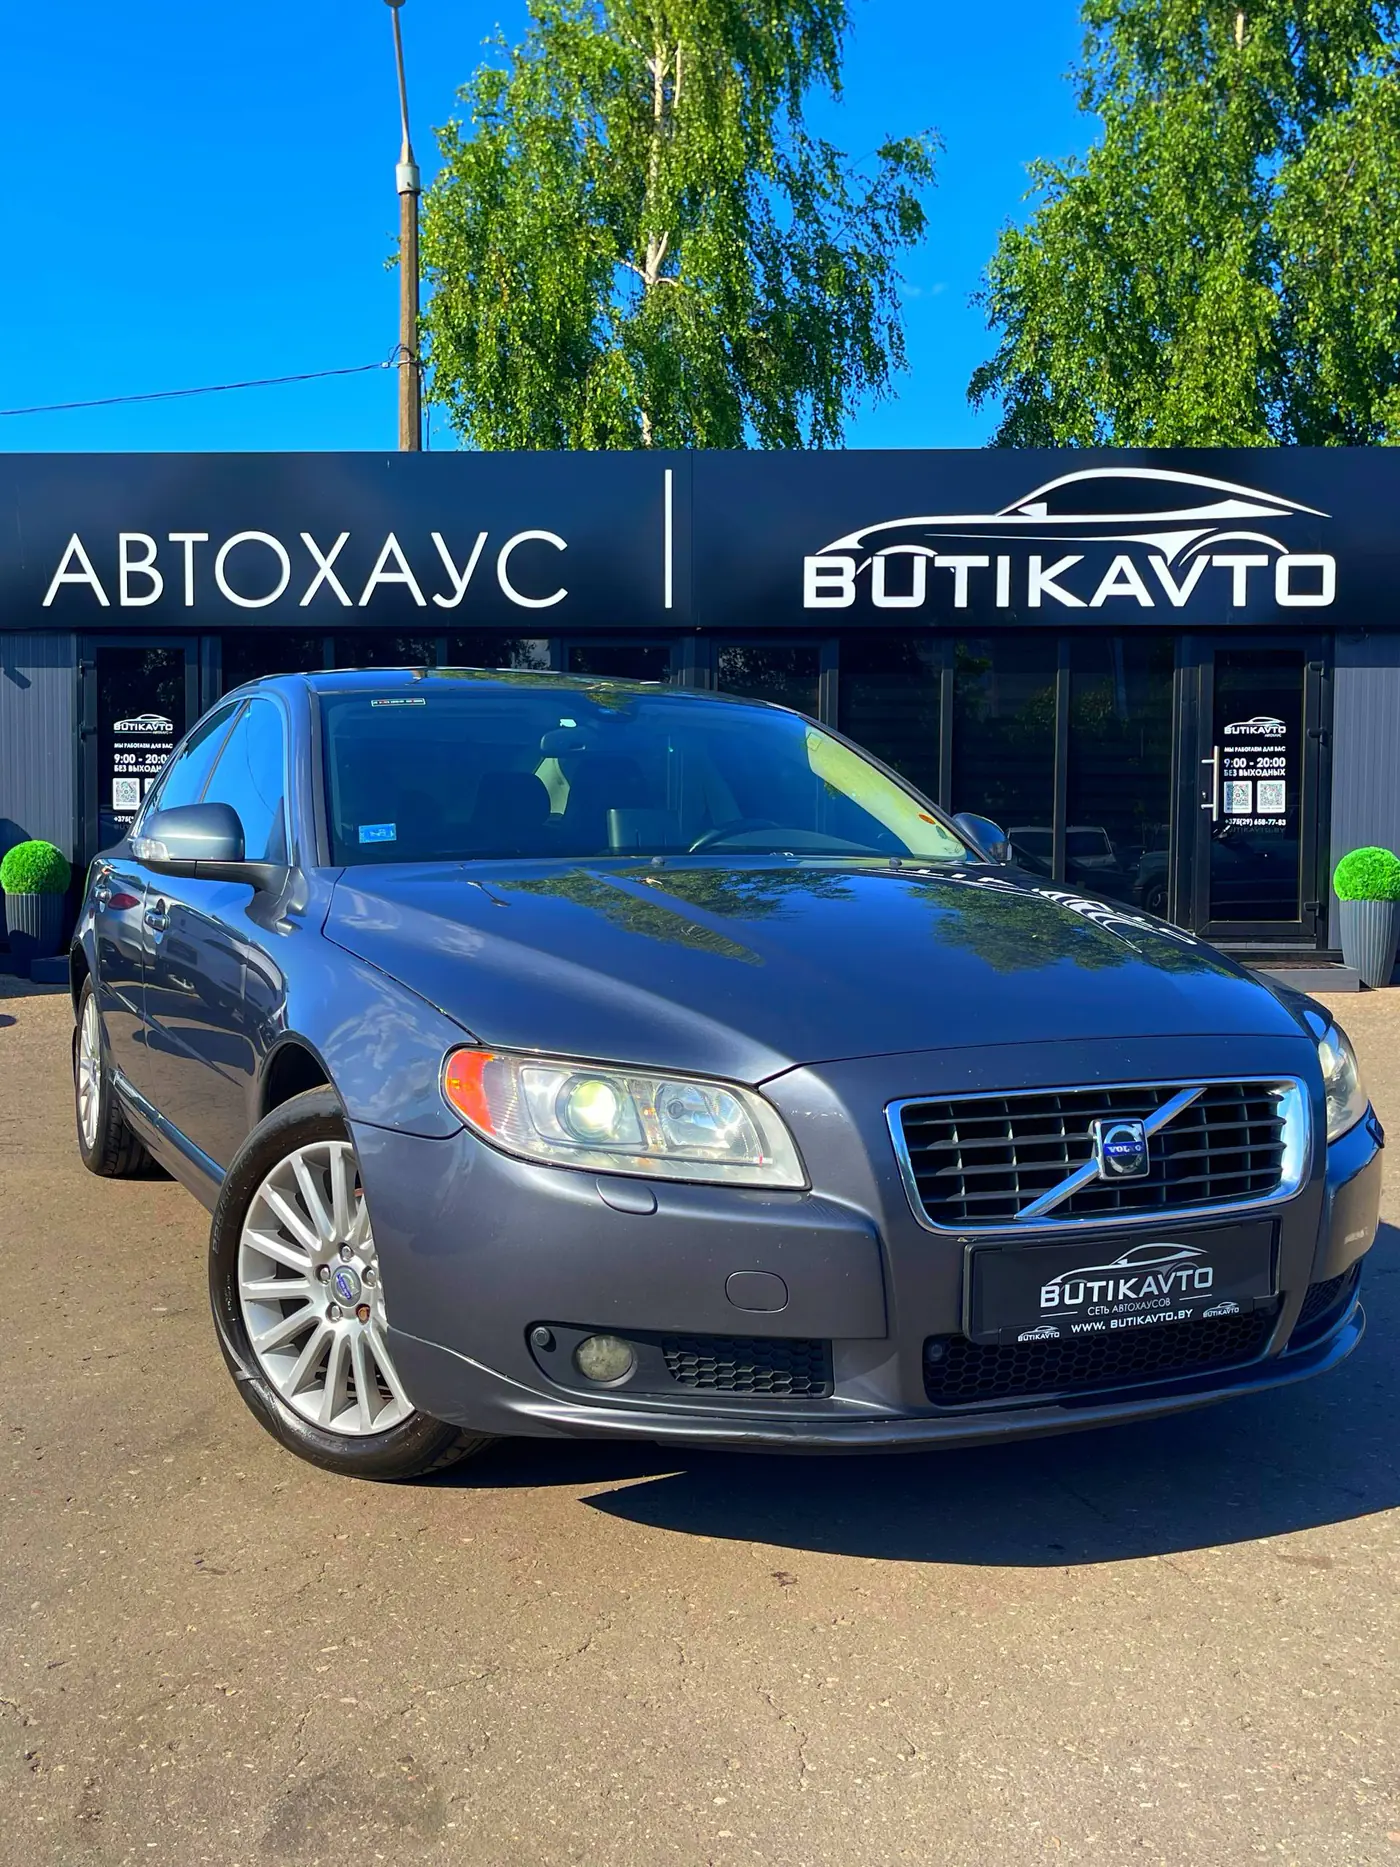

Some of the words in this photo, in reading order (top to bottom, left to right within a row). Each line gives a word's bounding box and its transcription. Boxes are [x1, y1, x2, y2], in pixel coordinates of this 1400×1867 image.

[42, 530, 569, 608] АВТОХАУС
[803, 553, 1337, 608] BUTIKAVTO
[113, 723, 173, 731] BUTIKAVTO
[1224, 726, 1287, 734] BUTIKAVTO
[114, 754, 135, 764] 9:00
[1224, 758, 1246, 767] 9:00
[1256, 757, 1286, 767] 20:00
[1239, 769, 1286, 777] ВЫХОДНЫХ
[1040, 1267, 1213, 1308] BUTIKAVTO
[1087, 1305, 1109, 1316] СЕТЬ
[1112, 1297, 1171, 1313] АВТОХАУСОВ
[1203, 1306, 1240, 1318] BUTIKAVTO
[1071, 1321, 1106, 1333] WWW.
[1110, 1308, 1194, 1329] BUTIKAVTO.BY
[1018, 1331, 1060, 1342] BUTIKAVTO
